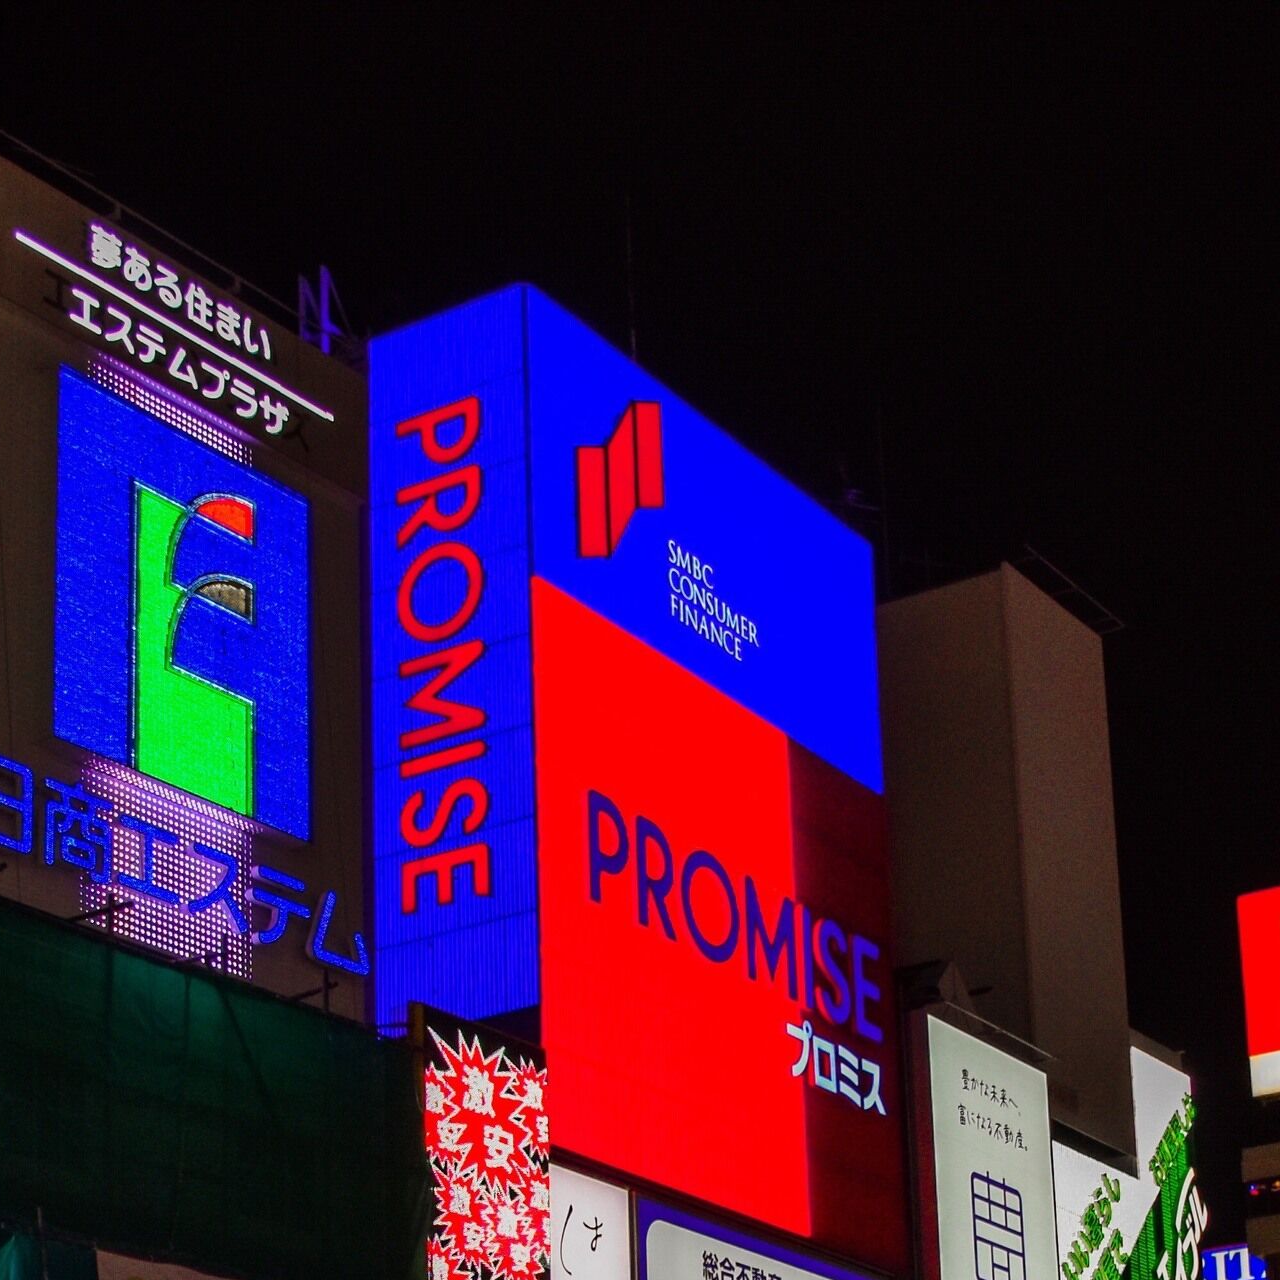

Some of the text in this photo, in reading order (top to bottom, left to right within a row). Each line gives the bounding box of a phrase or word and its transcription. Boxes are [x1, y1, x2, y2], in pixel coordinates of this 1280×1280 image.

[89, 222, 274, 361] 夢ある住まい
[69, 286, 290, 436] エステムプラザ
[667, 539, 713, 589] SMBC
[669, 567, 760, 648] CONSUMER
[395, 394, 492, 915] PROMISE
[671, 600, 744, 662] FINANCE
[587, 788, 884, 1044] PROMISE
[786, 1018, 888, 1117] プロミス
